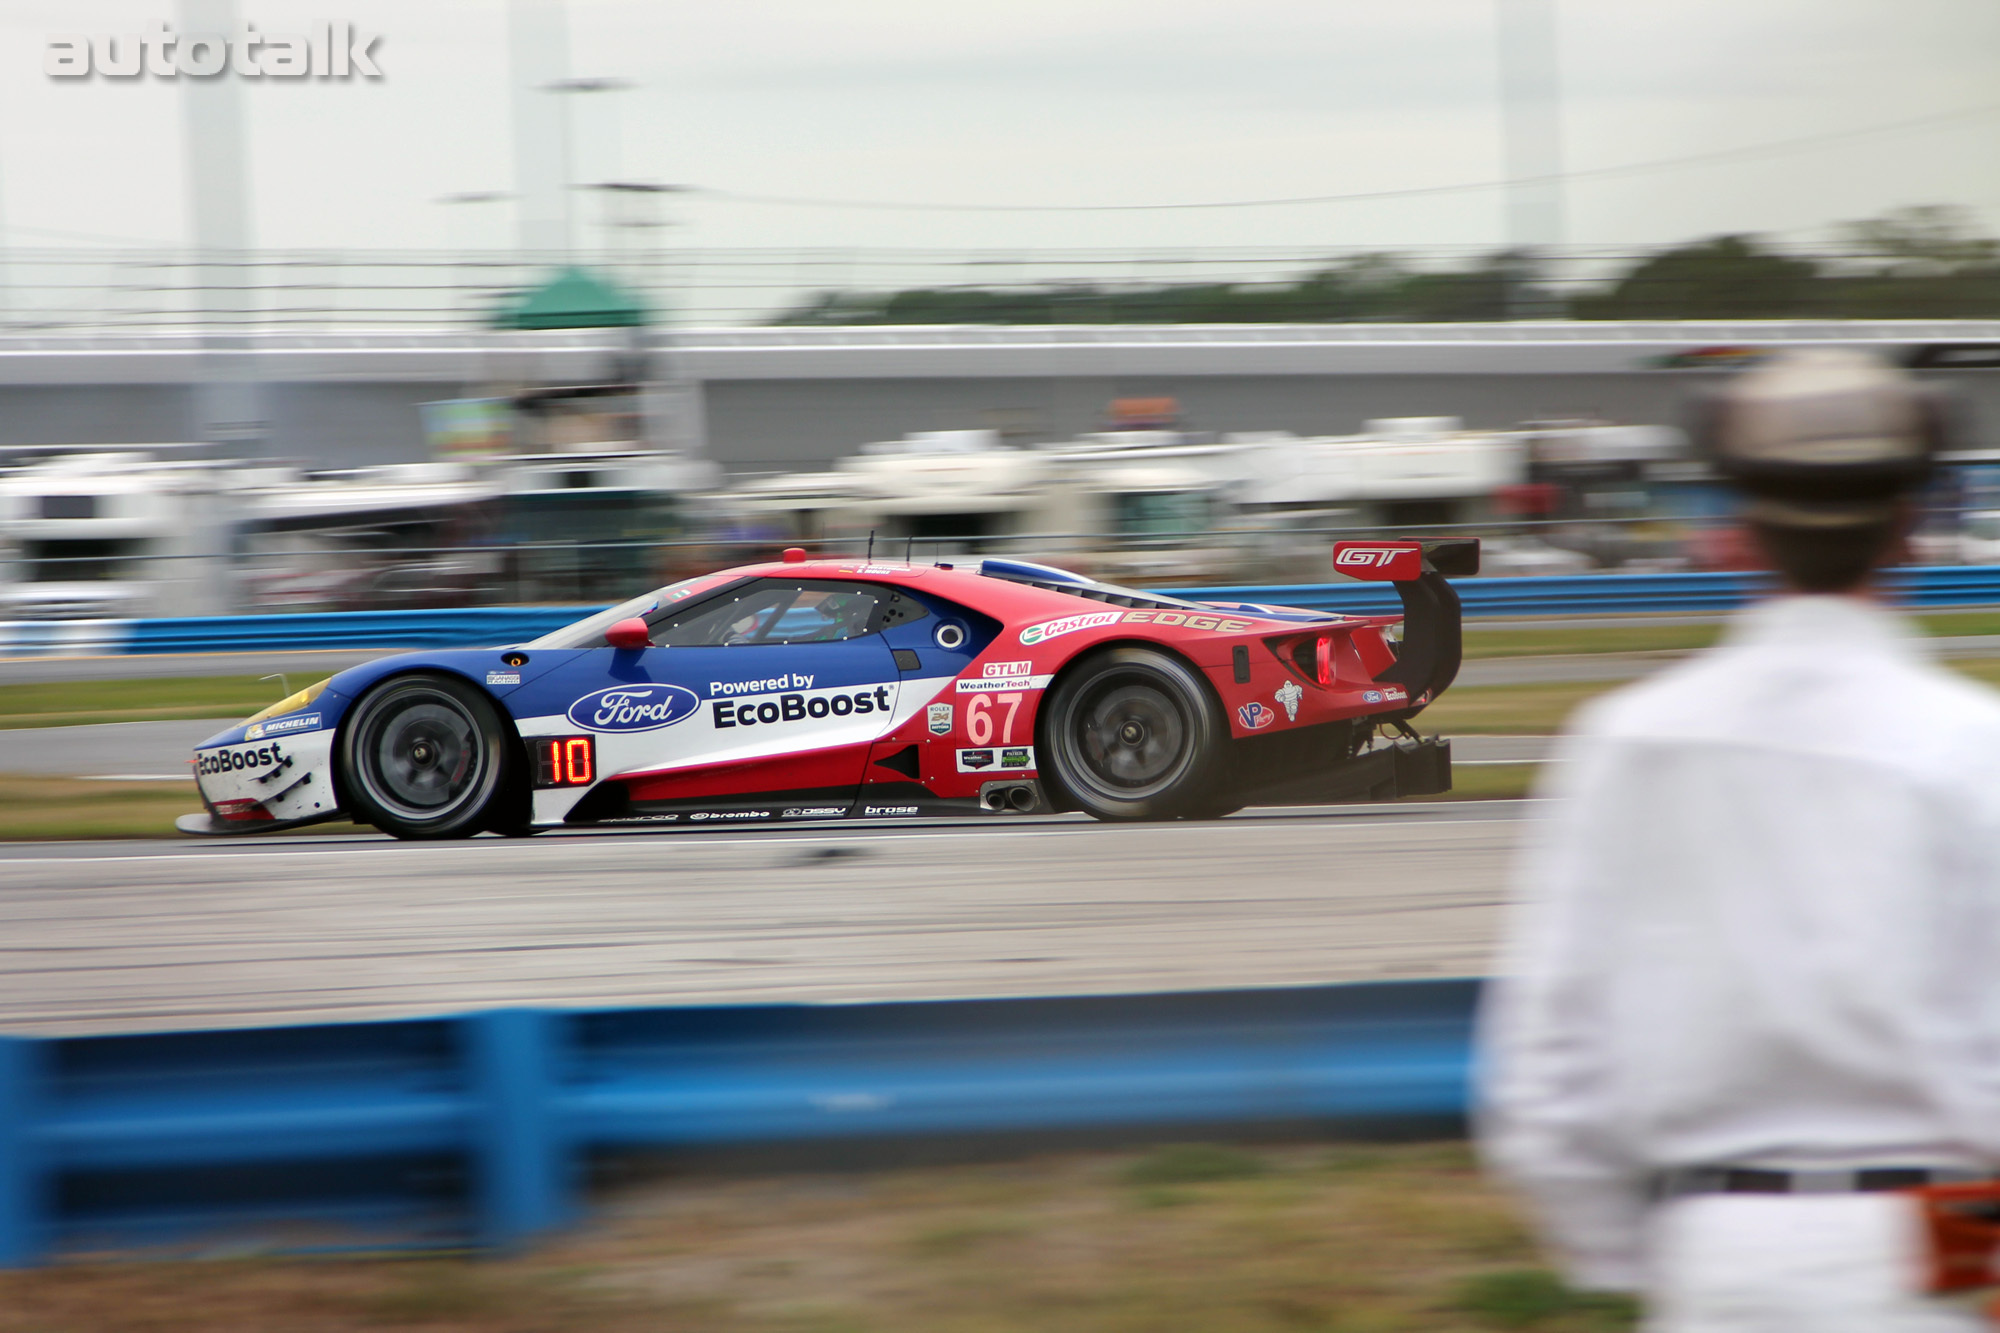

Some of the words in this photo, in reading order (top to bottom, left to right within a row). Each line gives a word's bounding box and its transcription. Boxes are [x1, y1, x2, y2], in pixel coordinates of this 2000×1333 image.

[1336, 547, 1418, 568] GT
[1044, 613, 1114, 637] Castrol
[1121, 611, 1253, 633] EDGE
[985, 662, 1030, 676] GTLM
[709, 673, 789, 696] Powered
[792, 673, 815, 690] by
[960, 680, 1030, 690] WeatherTech
[594, 690, 674, 726] Ford
[932, 713, 949, 721] 24
[966, 692, 1023, 746] 67
[1239, 702, 1263, 728] VP
[265, 716, 319, 731] MICHELIN
[198, 742, 284, 776] EcoBoost
[552, 739, 592, 783] 10
[709, 811, 770, 819] brembo
[864, 806, 919, 814] brose
